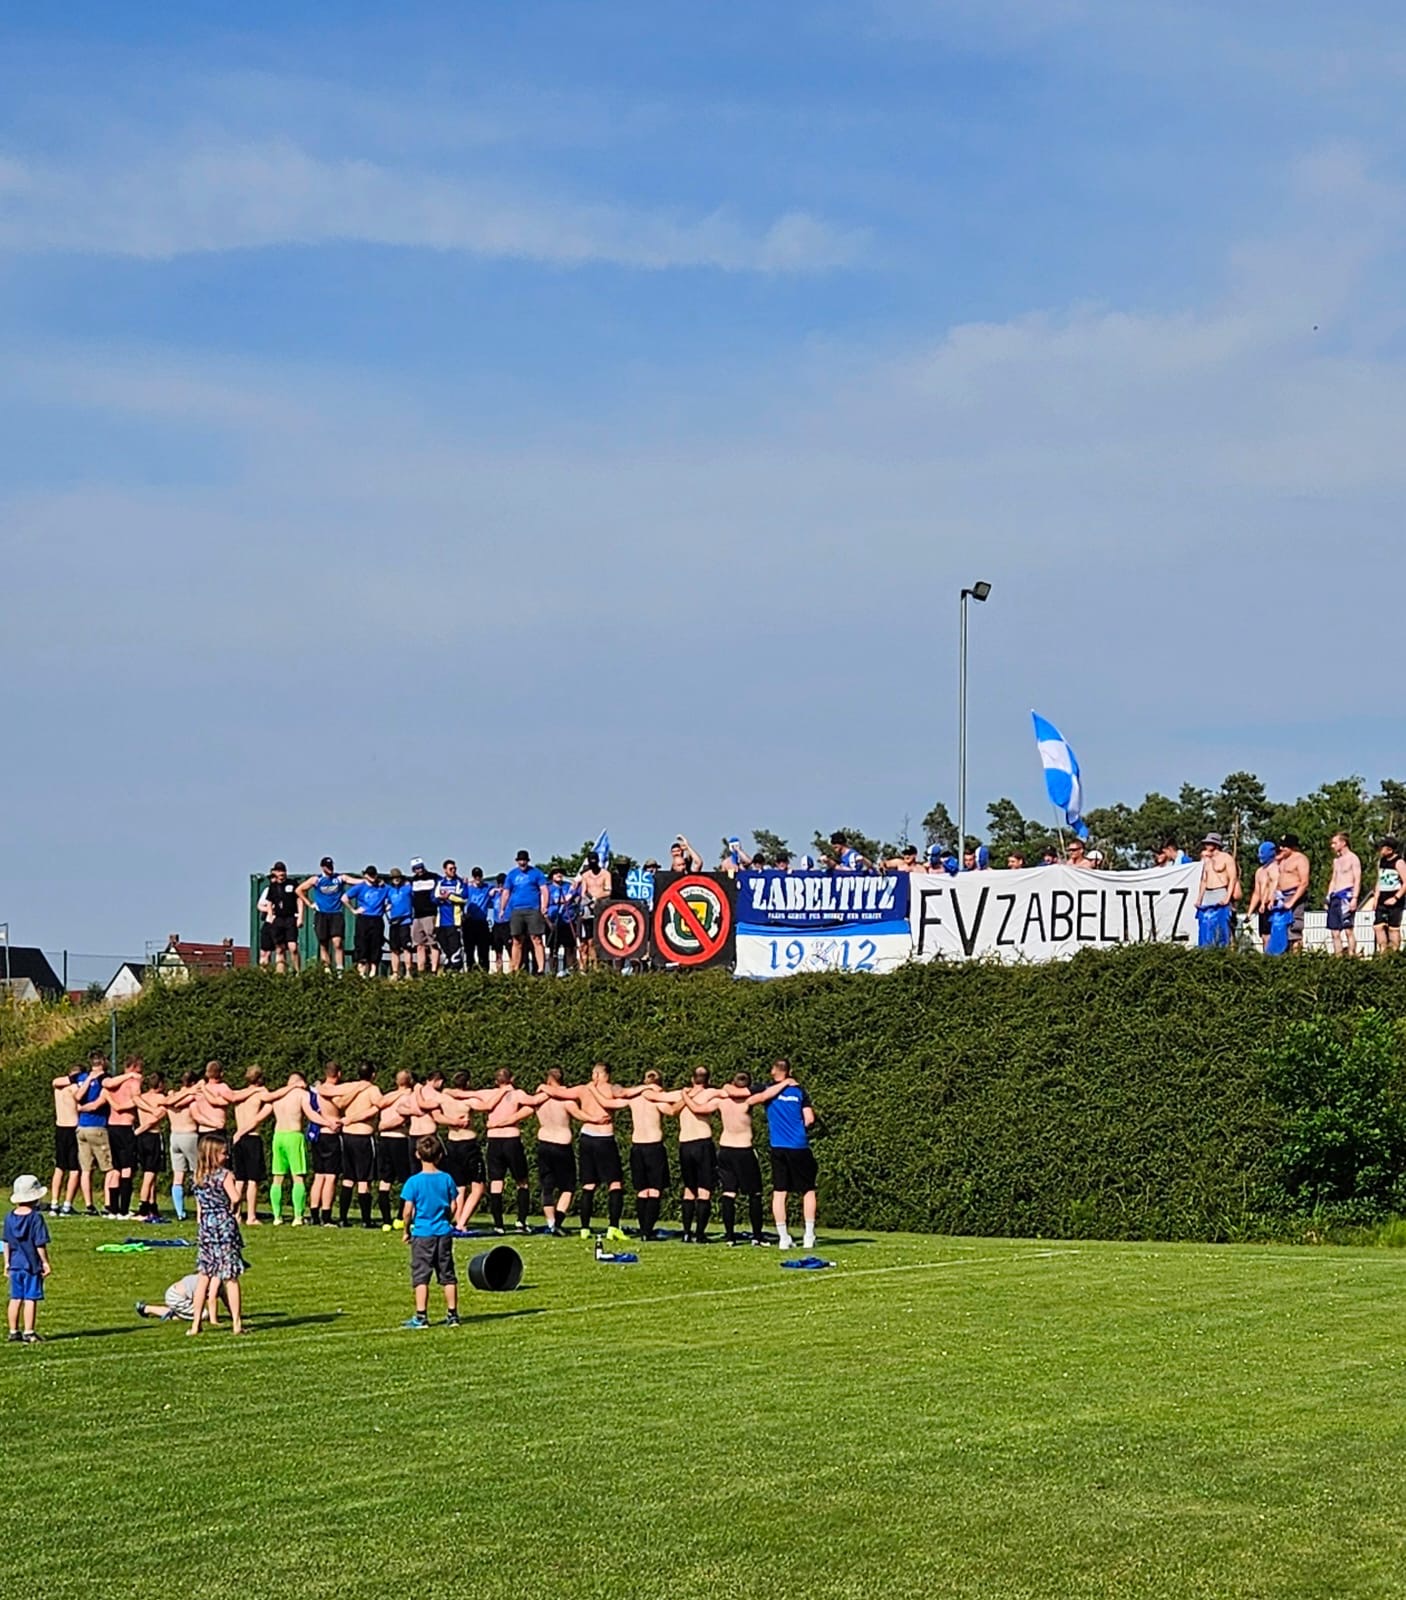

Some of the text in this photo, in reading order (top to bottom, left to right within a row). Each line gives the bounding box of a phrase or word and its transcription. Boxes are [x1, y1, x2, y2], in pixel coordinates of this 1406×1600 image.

[749, 876, 898, 911] ZABELTITZ
[917, 886, 1190, 957] FV ZABELTITZ
[768, 938, 877, 971] 19 12
